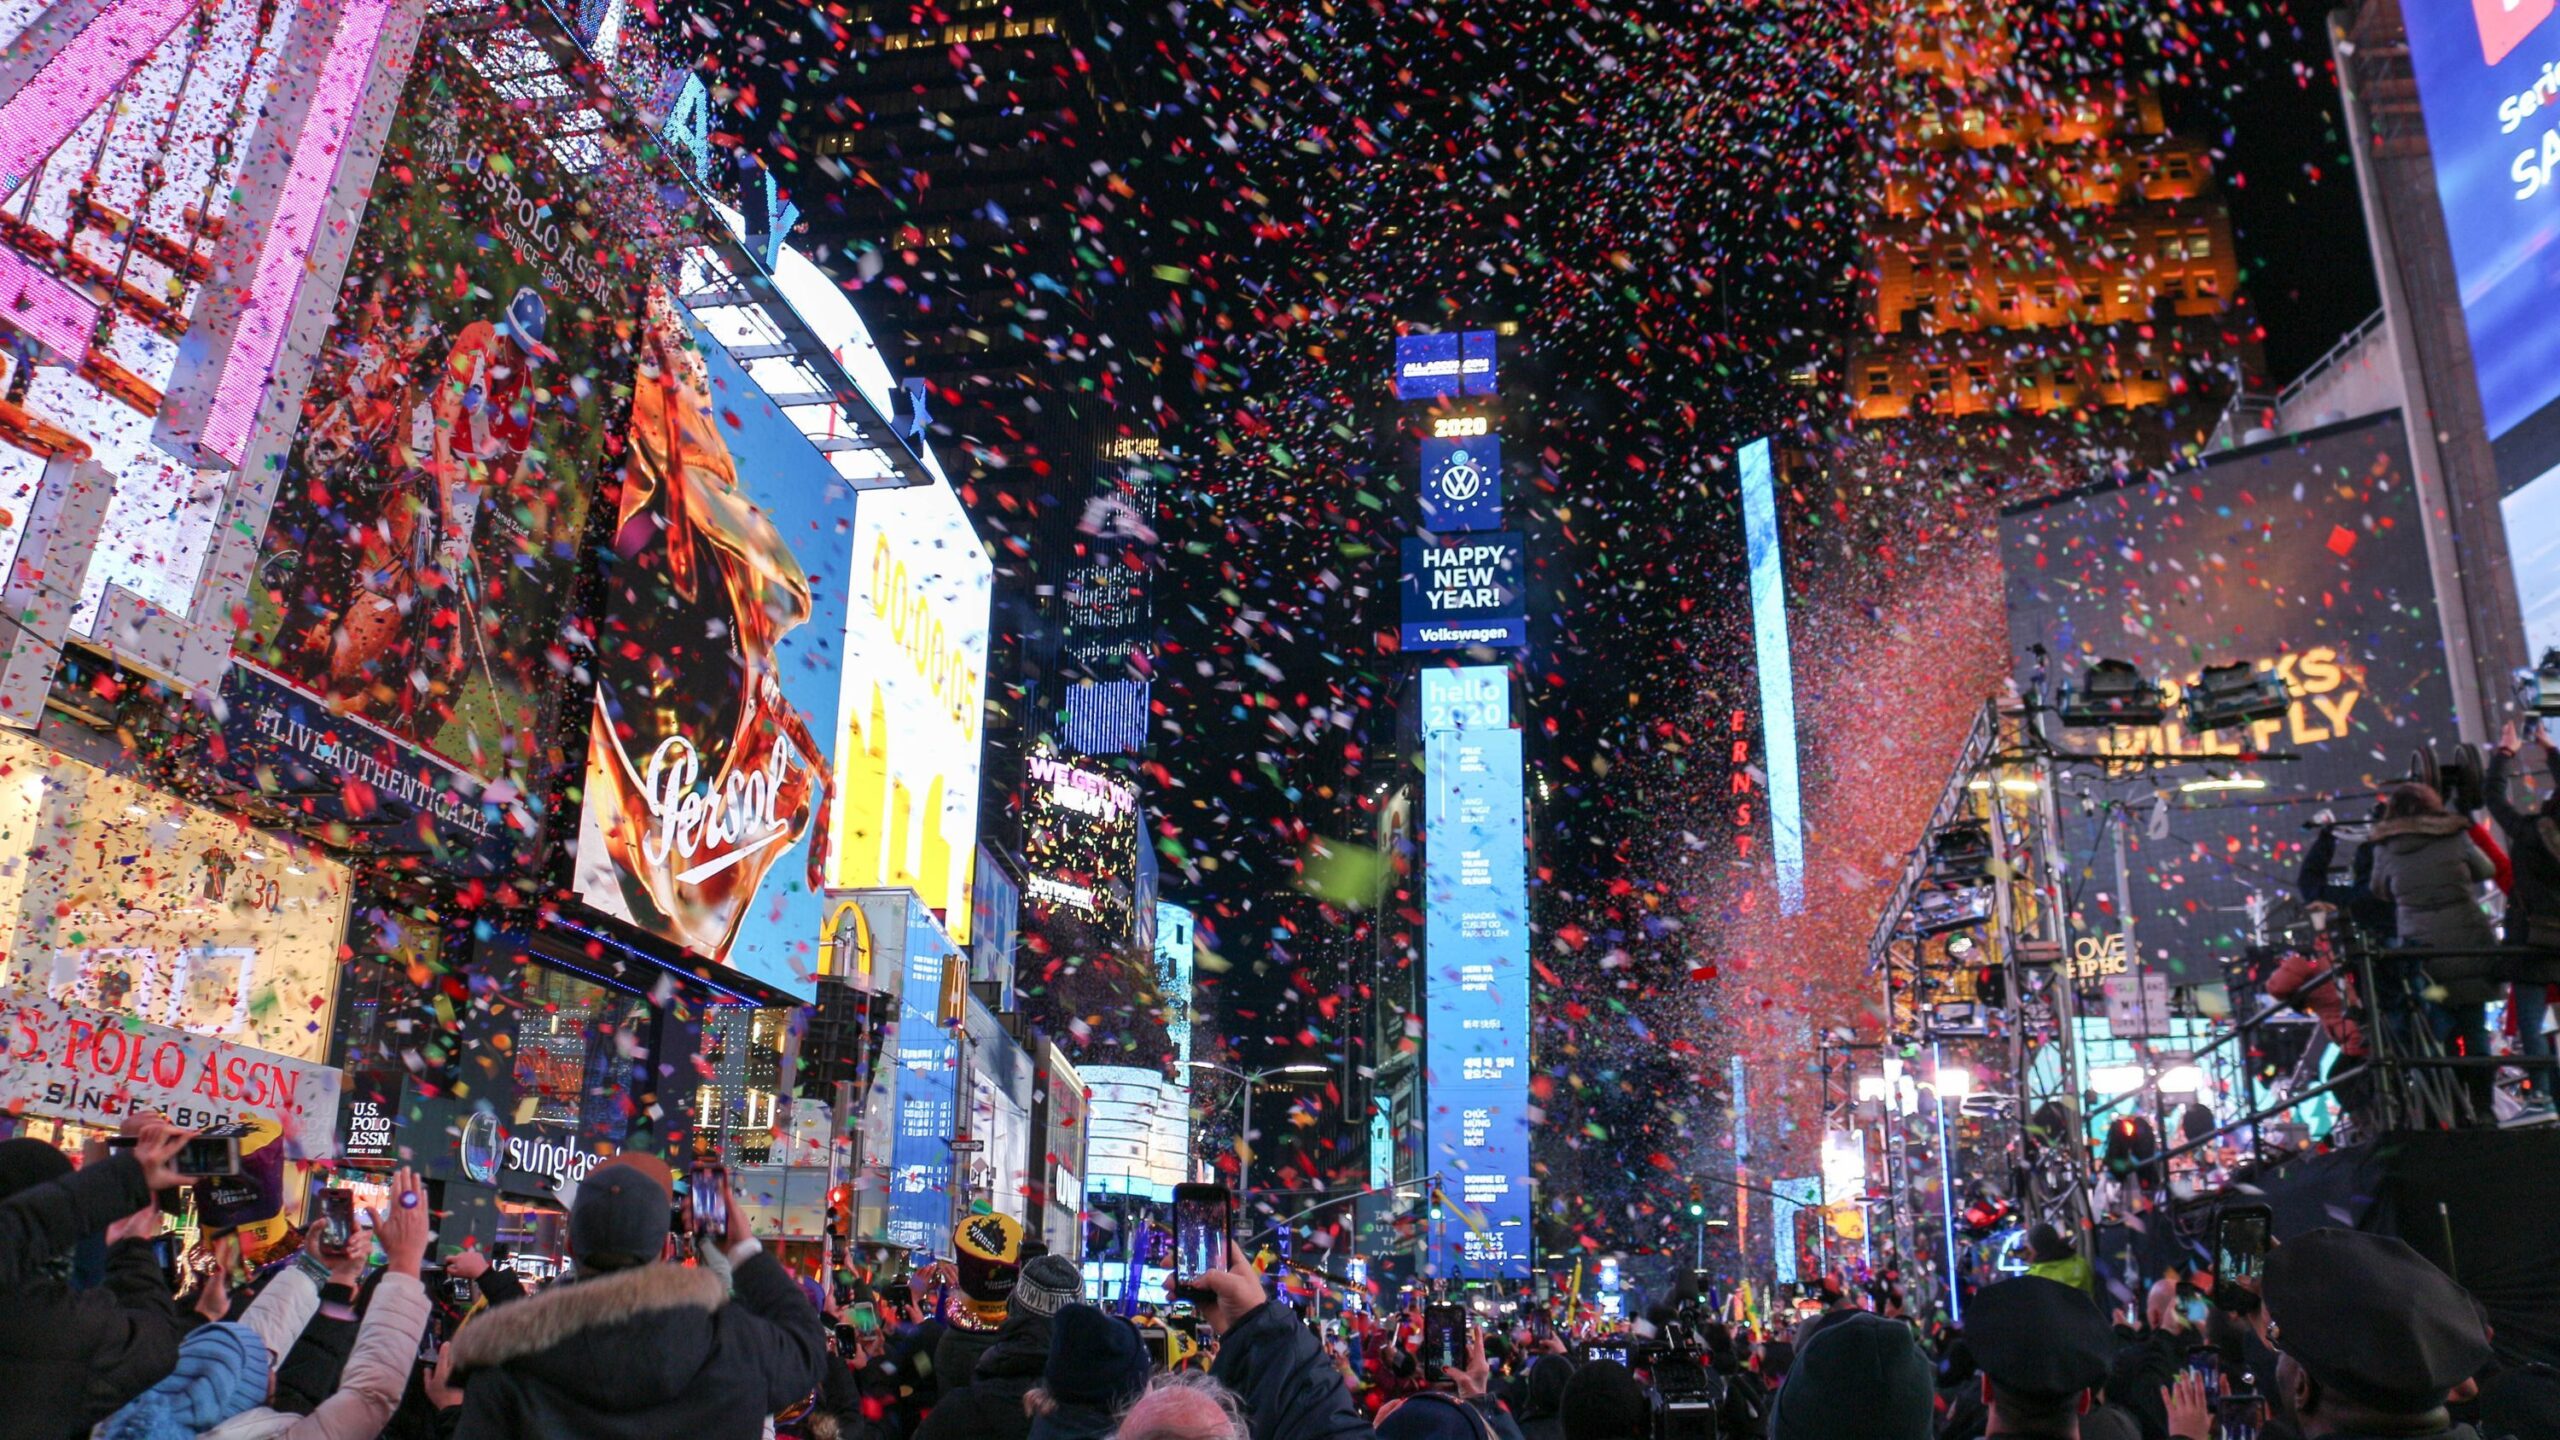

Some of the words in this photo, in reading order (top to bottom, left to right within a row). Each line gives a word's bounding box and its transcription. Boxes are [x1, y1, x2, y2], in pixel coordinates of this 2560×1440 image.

[2499, 61, 2560, 134] Seri
[2511, 122, 2560, 200] SA
[503, 181, 560, 252] POLO
[504, 223, 540, 267] SINCE
[541, 262, 568, 295] 1890
[1434, 416, 1488, 438] 2020
[1422, 546, 1505, 568] HAPPY
[1434, 567, 1495, 588] NEW
[1426, 588, 1501, 609] YEAR!
[873, 532, 974, 742] 00:00:05
[1420, 626, 1507, 643] Volkswagen
[1429, 679, 1500, 703] hello
[1430, 704, 1501, 727] 2020
[2253, 690, 2359, 752] FLY
[1029, 757, 1069, 785] WE
[1730, 709, 1753, 858] ERNST
[644, 733, 789, 866] Persol
[61, 1017, 185, 1089] POLO
[192, 1049, 303, 1115] ASSN.
[44, 1082, 145, 1123] SINCE
[354, 1102, 379, 1116] U.S.
[348, 1131, 391, 1145] ASSN.
[350, 1117, 390, 1131] POLO
